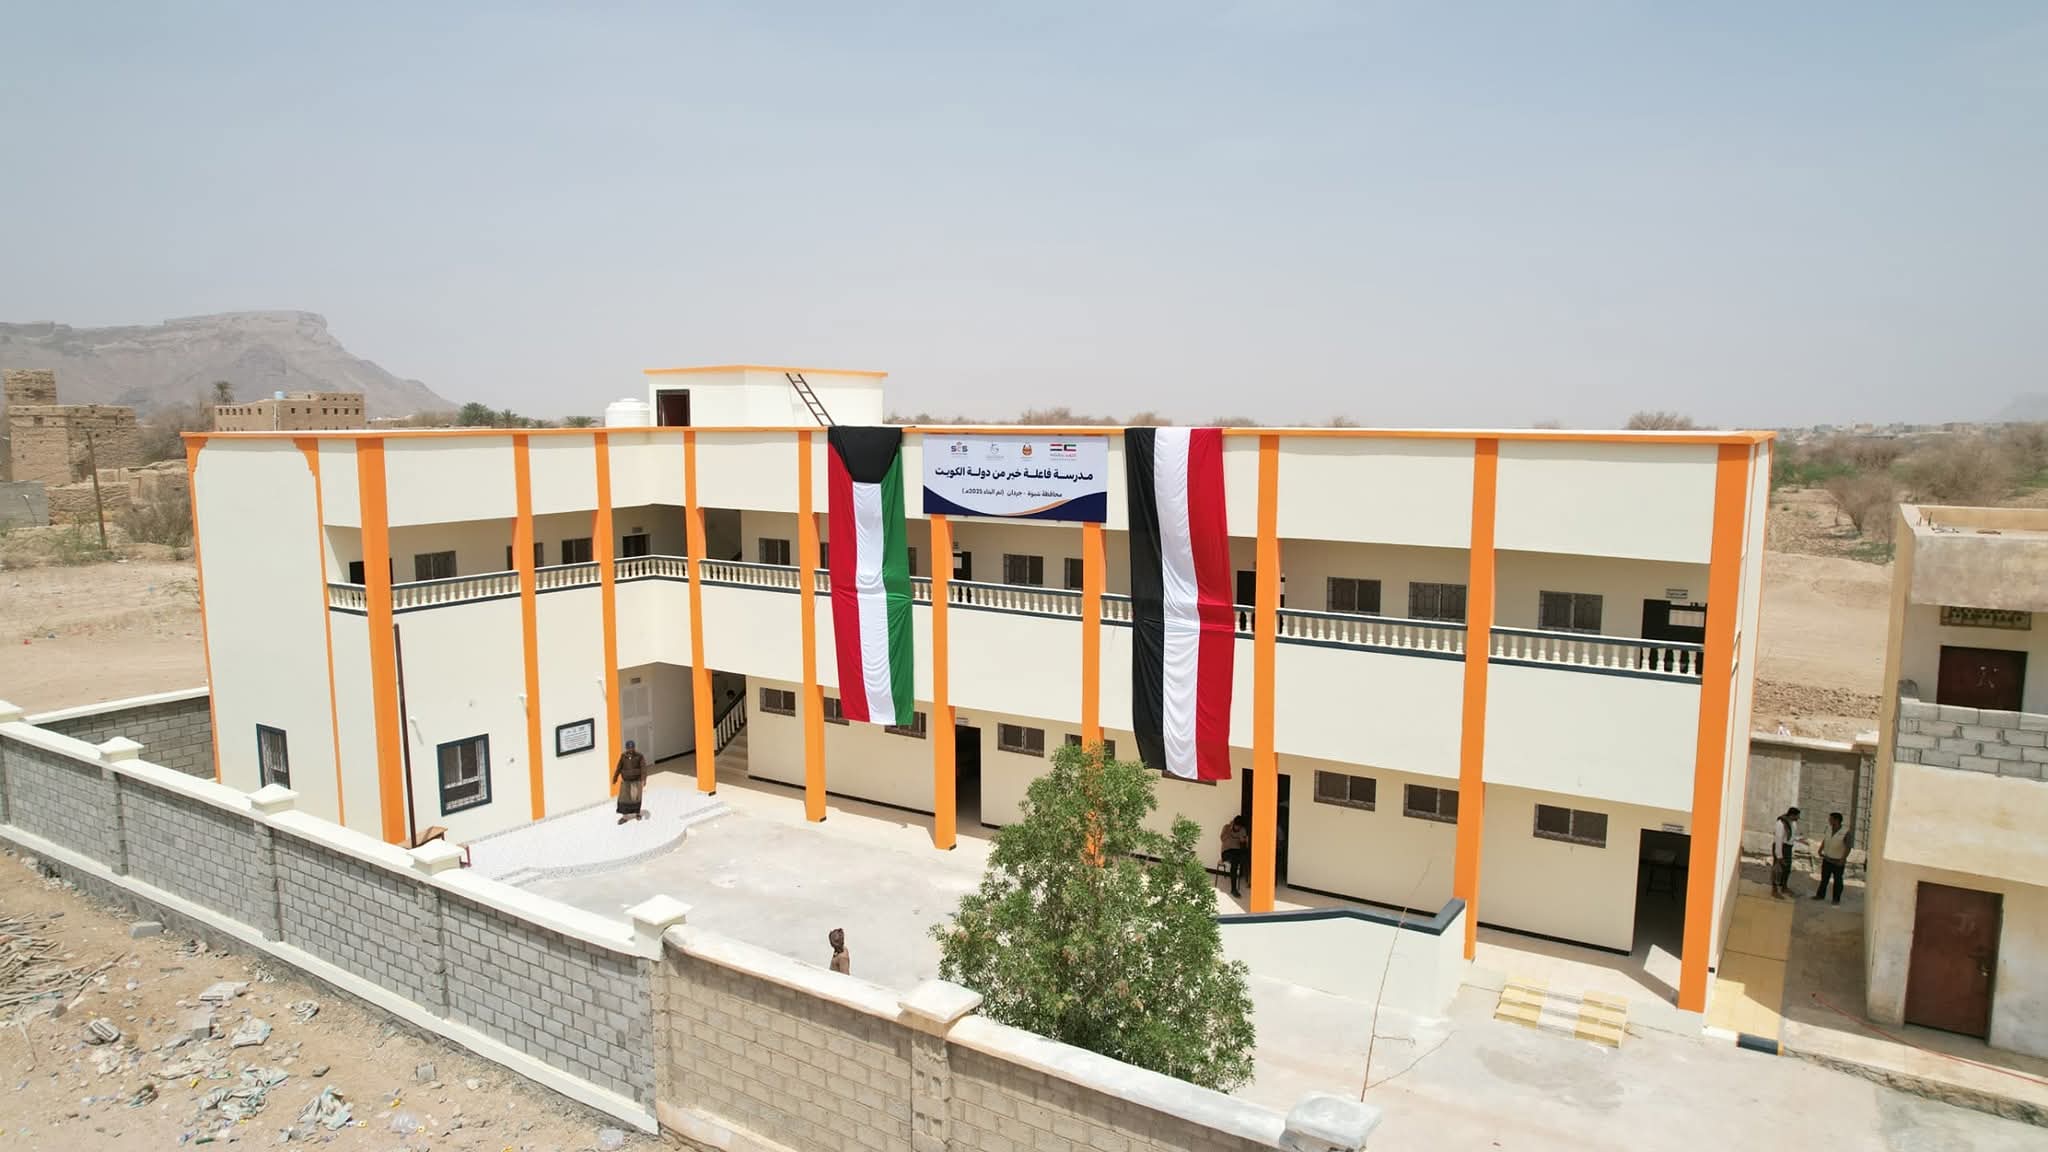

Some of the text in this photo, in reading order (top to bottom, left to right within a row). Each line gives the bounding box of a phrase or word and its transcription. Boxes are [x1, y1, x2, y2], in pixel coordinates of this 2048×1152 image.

[935, 466, 1093, 482] مدرسة فاعلة خير من دولة الكويت
